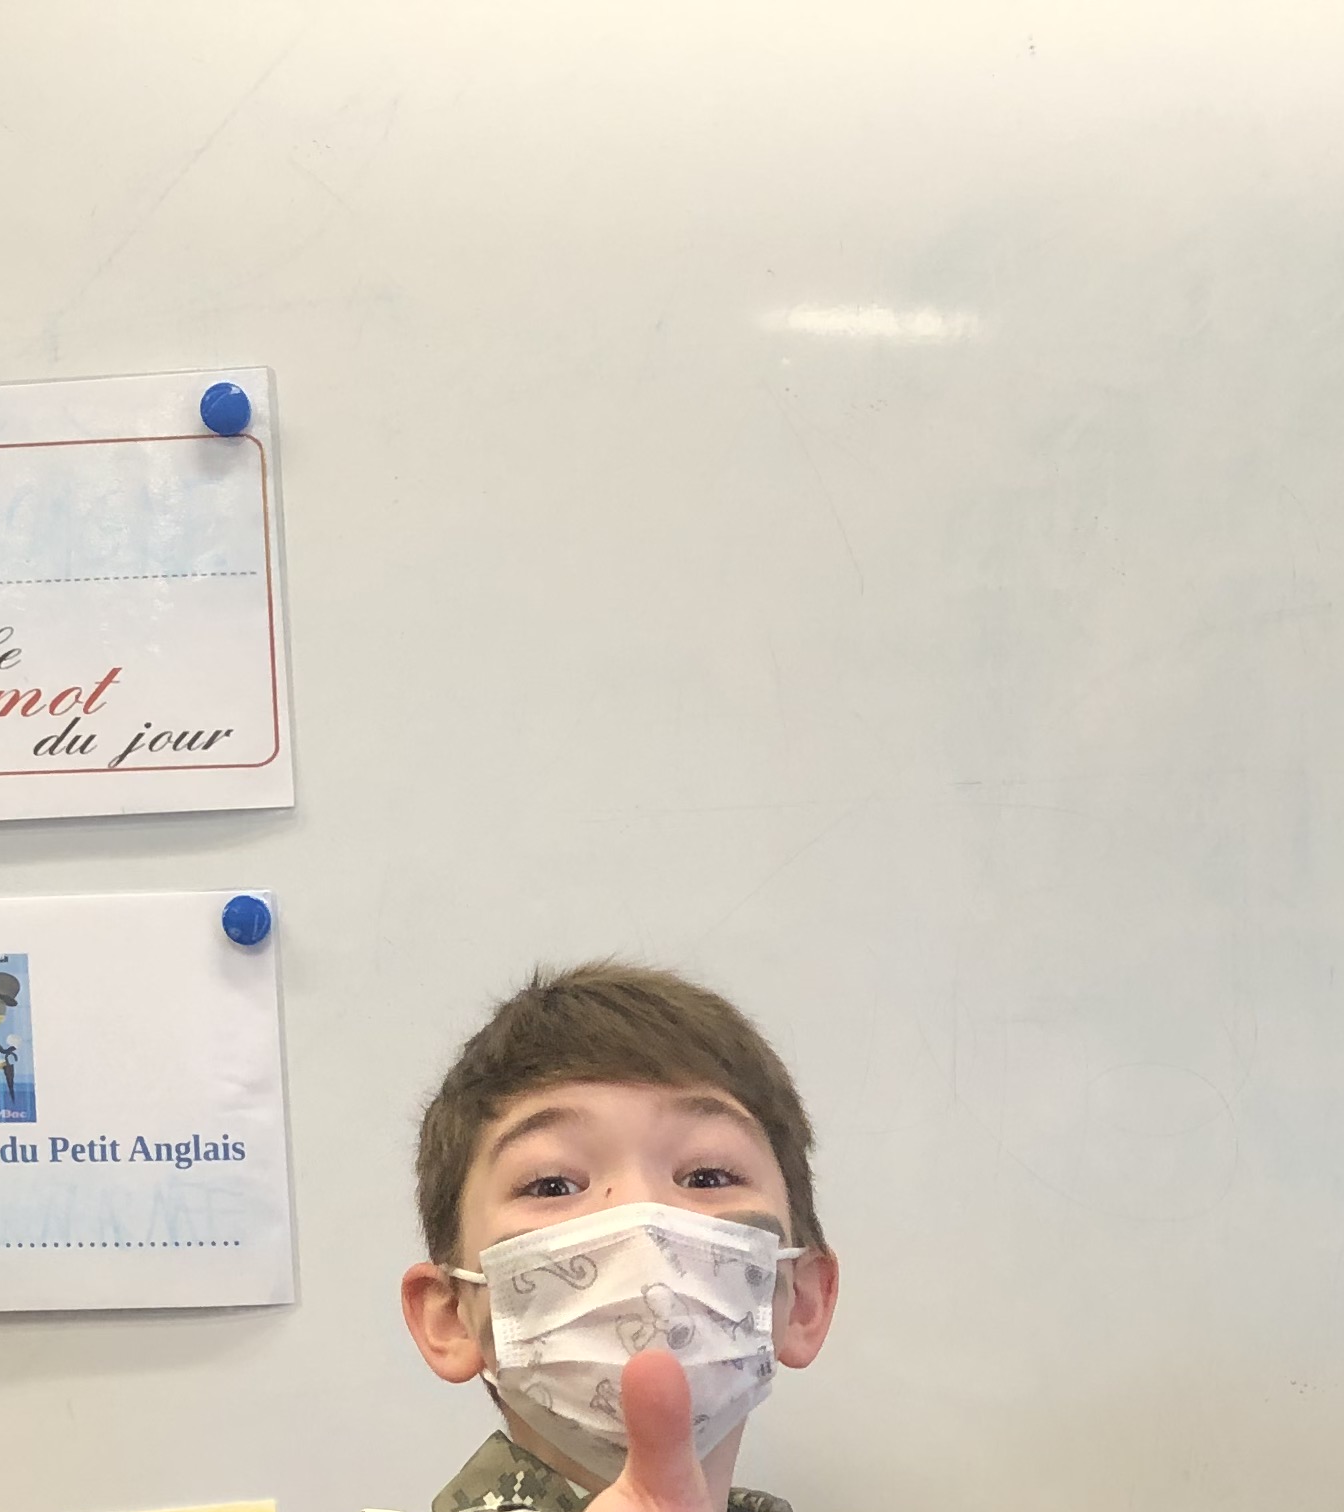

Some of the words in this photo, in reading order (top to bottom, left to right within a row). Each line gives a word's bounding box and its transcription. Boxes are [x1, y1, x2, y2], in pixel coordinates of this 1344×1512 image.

[33, 716, 98, 757] du
[107, 724, 234, 768] jour
[0, 1136, 39, 1164] du
[48, 1135, 122, 1164] Petit
[128, 1133, 247, 1169] Anglais
